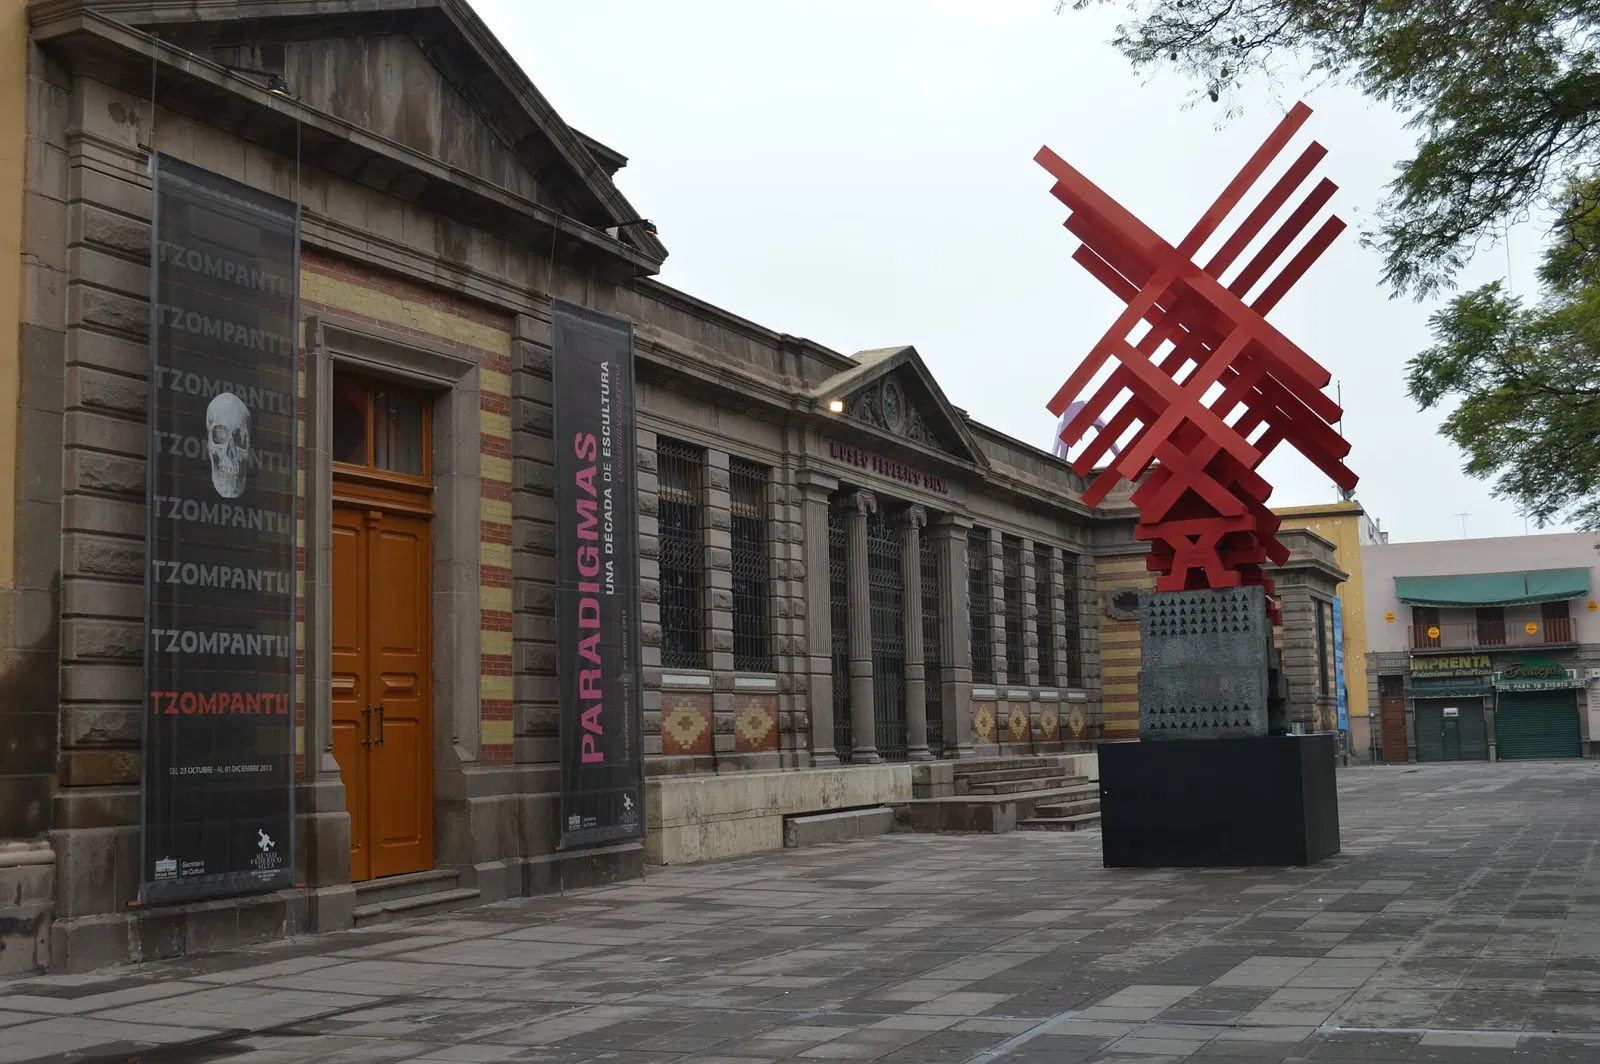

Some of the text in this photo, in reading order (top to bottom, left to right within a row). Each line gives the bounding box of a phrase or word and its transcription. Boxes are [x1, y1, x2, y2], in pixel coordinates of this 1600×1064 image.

[154, 431, 291, 475] TZONTLI
[829, 442, 949, 495] MUSEO FEDERICO SILVA
[600, 361, 615, 595] UNA DÉCADA DE ESCULTURA
[153, 495, 291, 534] TZOMPANTLI
[152, 559, 290, 594] TZOMPANTLI
[574, 432, 604, 764] PARADIGMAS
[151, 628, 289, 658] TZOMPANTLI
[1409, 655, 1491, 670] IMPRENTA
[150, 691, 288, 716] TZOMPANTLI
[169, 767, 179, 775] DEL
[179, 767, 187, 775] 23
[187, 766, 213, 775] OCTUBRE
[260, 764, 272, 772] 2013
